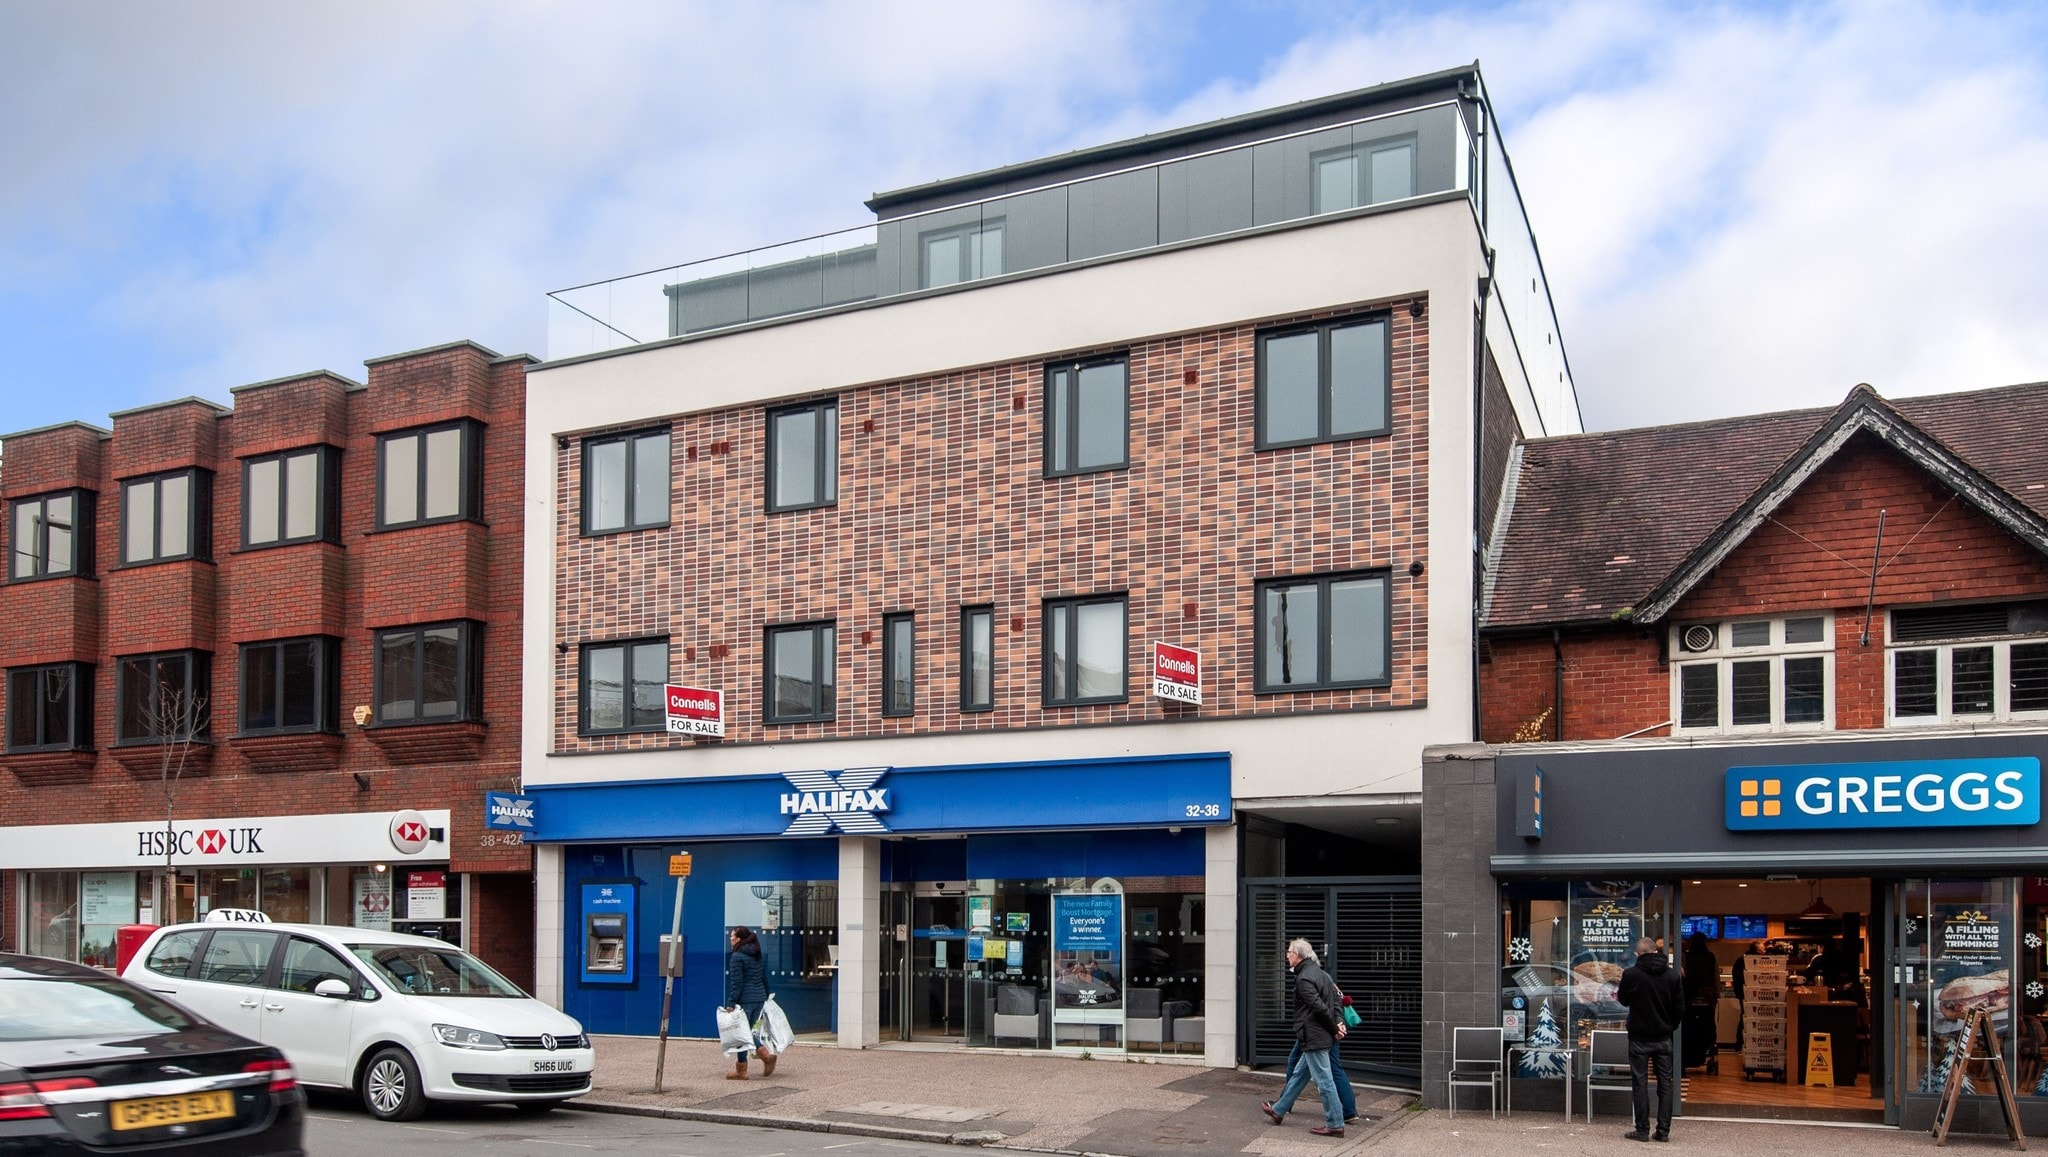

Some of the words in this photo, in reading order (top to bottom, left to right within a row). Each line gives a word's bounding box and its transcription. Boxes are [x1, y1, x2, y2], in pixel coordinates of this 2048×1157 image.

[1159, 654, 1195, 674] Connells
[1158, 682, 1176, 697] FOR
[1177, 687, 1198, 701] SALE
[671, 695, 717, 712] Connells
[671, 720, 693, 731] FOR
[695, 722, 719, 734] SALE
[1795, 771, 2024, 815] GREGGS
[781, 789, 888, 814] HALIFAX
[492, 806, 534, 818] HALIFAX
[1186, 804, 1220, 817] 32-36
[138, 830, 194, 856] HSBC
[229, 828, 264, 854] UK
[220, 910, 265, 923] TAXI
[1070, 917, 1105, 926] Everyone's
[1582, 919, 1603, 927] IT'S
[1606, 919, 1629, 927] THE
[534, 1061, 556, 1072] SH66
[557, 1061, 573, 1071] UUG
